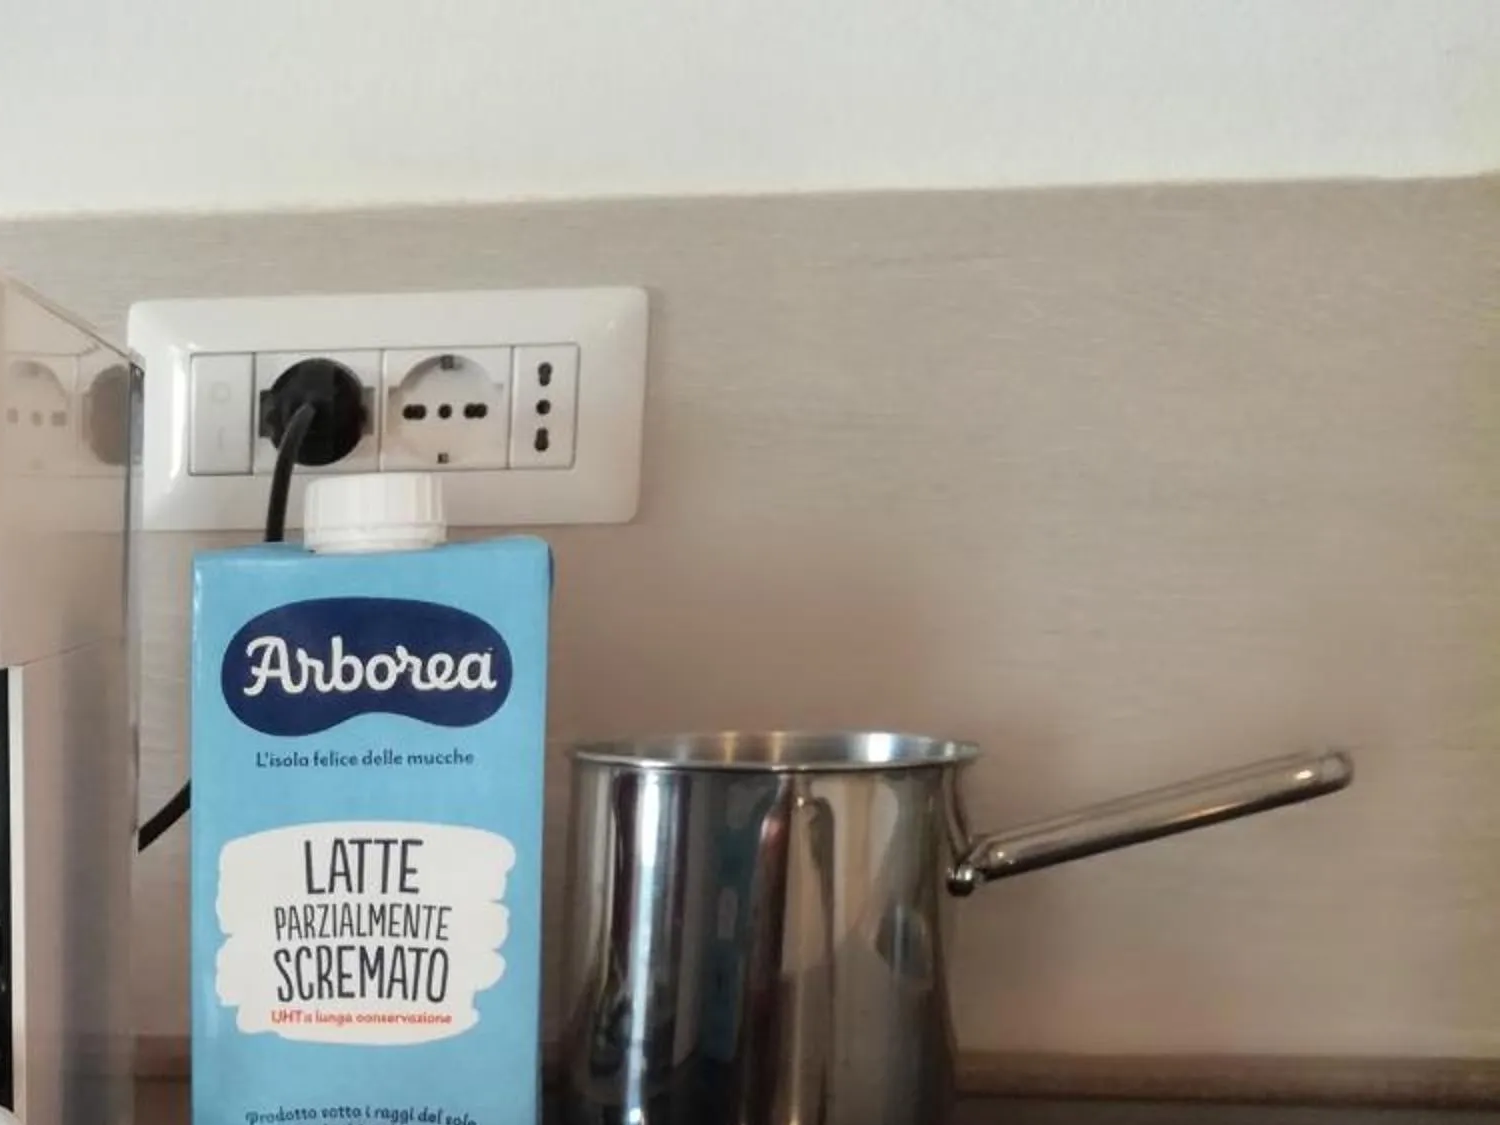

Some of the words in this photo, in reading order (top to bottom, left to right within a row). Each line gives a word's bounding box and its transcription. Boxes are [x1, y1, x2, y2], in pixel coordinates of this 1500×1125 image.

[243, 635, 498, 697] Arborea
[256, 751, 309, 768] L'isola
[313, 751, 359, 767] felice
[362, 749, 403, 766] delle
[407, 748, 475, 765] mucche
[304, 838, 424, 895] LATTE
[274, 902, 453, 941] PARZIALMENTE
[273, 945, 450, 1004] SCREMATO
[271, 1009, 302, 1024] UHT
[315, 1010, 353, 1028] lunga
[355, 1011, 453, 1025] conservazione
[245, 1106, 317, 1125] Prodotto
[321, 1107, 361, 1119] sotto
[374, 1107, 415, 1124] raggi
[418, 1107, 442, 1123] del
